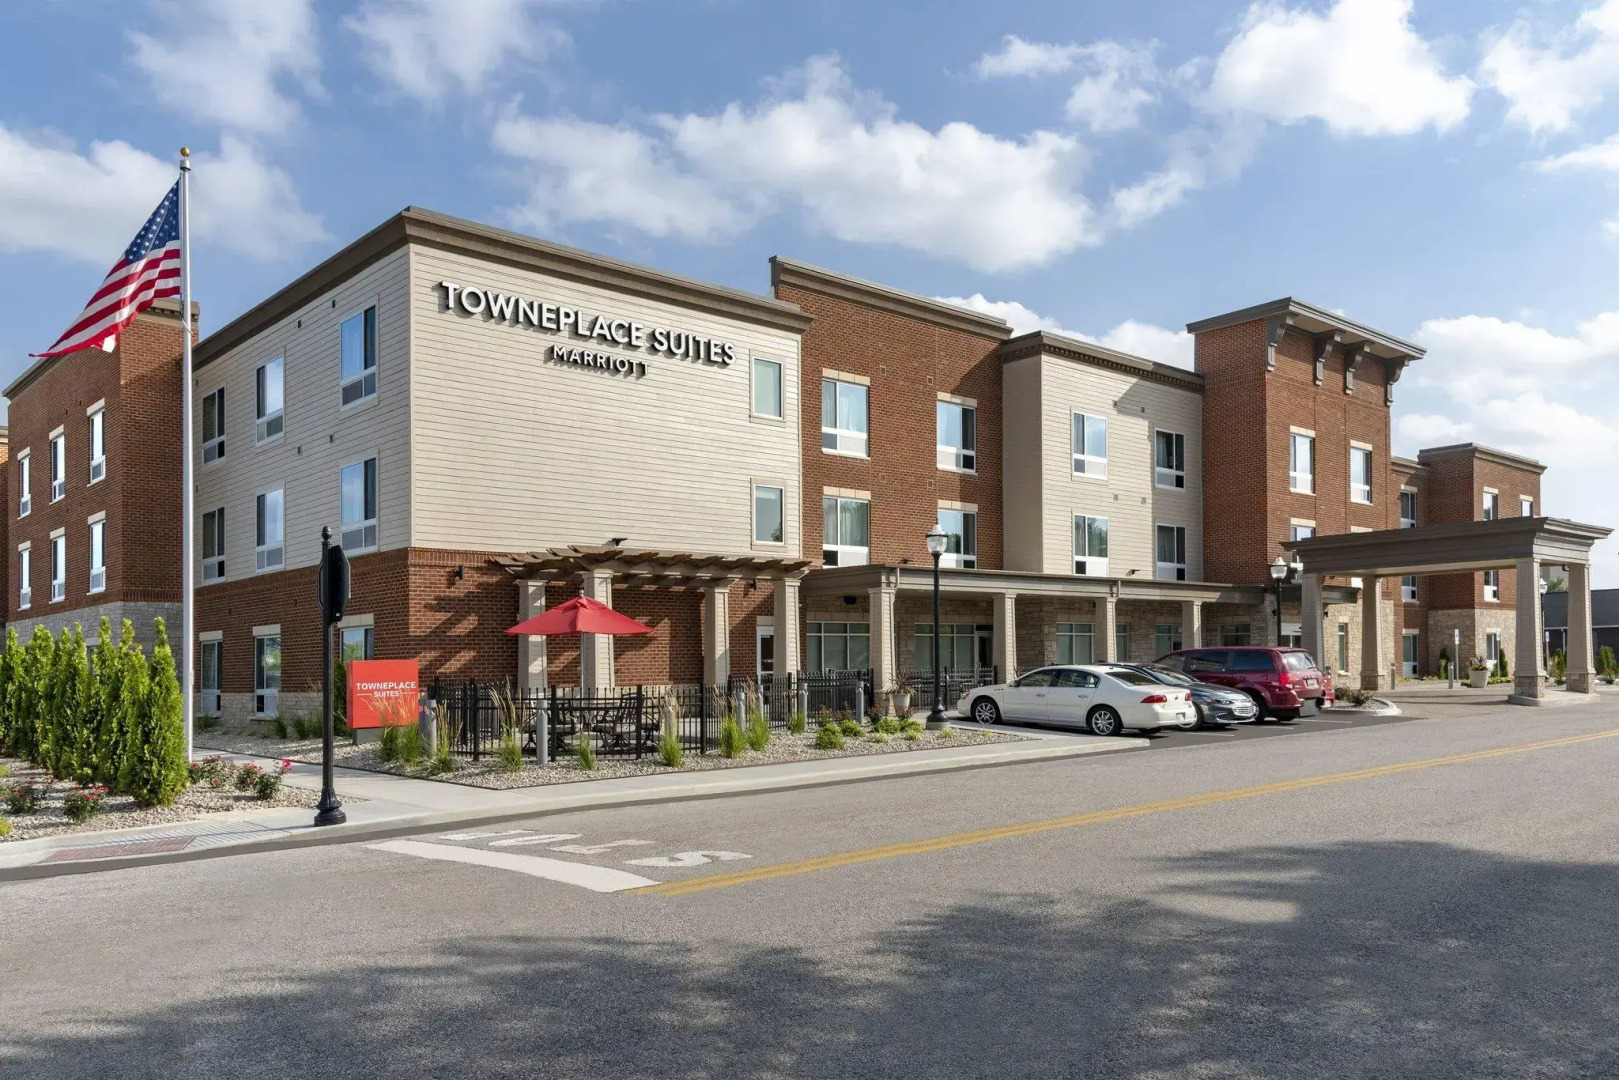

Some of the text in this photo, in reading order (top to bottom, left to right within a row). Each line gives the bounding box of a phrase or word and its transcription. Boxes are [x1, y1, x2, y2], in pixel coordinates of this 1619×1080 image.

[441, 280, 737, 365] TOWNEPLACE SUITES
[552, 344, 650, 376] MARRIOTT
[356, 681, 417, 691] TOWNEPLACE
[373, 690, 400, 698] SUITES
